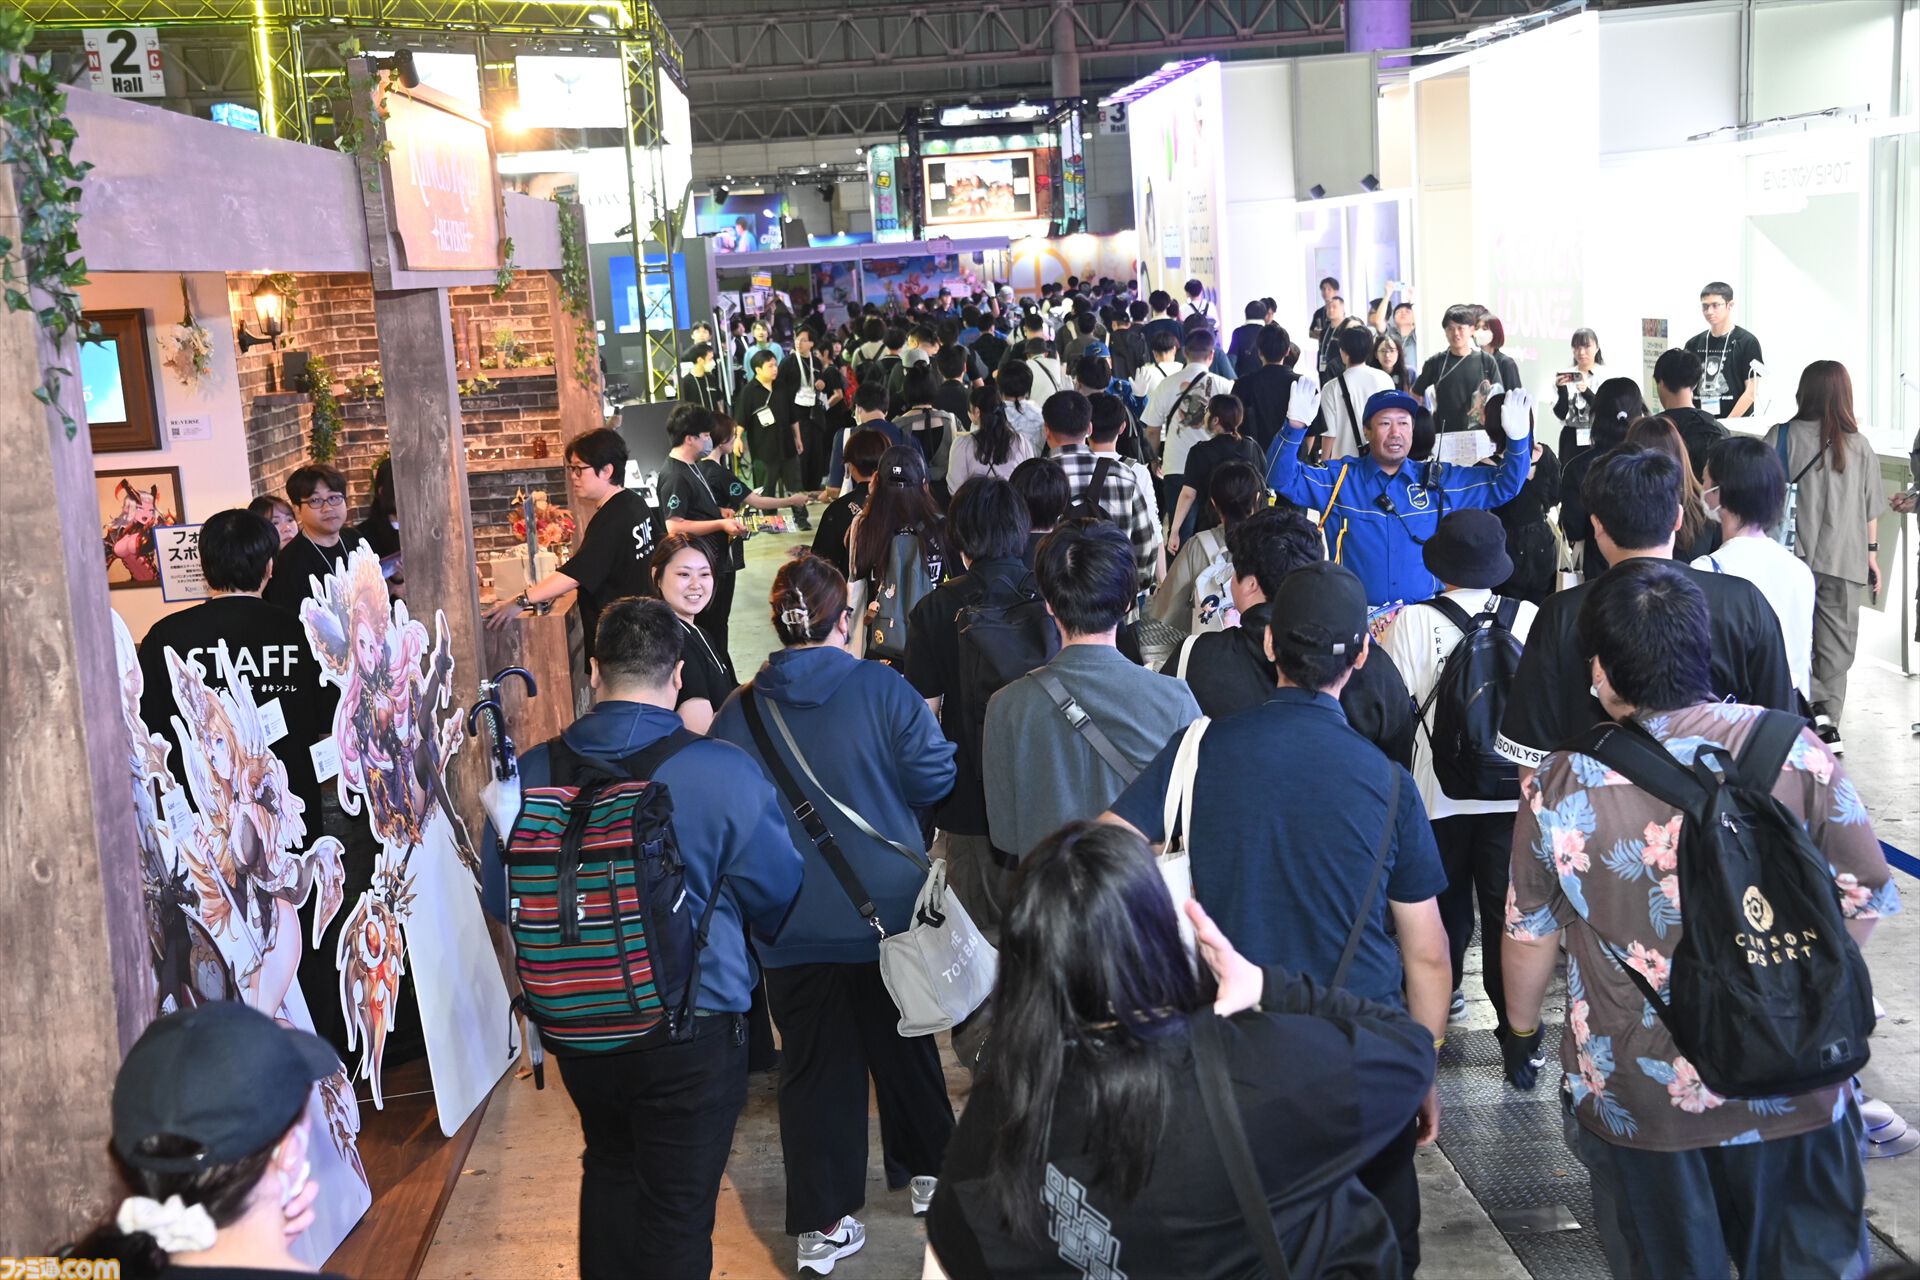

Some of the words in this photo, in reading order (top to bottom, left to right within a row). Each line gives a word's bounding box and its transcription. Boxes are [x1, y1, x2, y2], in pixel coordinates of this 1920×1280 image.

[88, 54, 99, 68] N
[107, 29, 141, 75] 2
[149, 54, 159, 67] C
[112, 77, 143, 93] Hall
[1110, 101, 1125, 123] 3
[1815, 161, 1852, 186] SPOT
[1497, 287, 1575, 340] LOUNGE
[173, 531, 199, 545] フォ
[168, 546, 198, 562] スポ
[186, 645, 299, 680] STAFF
